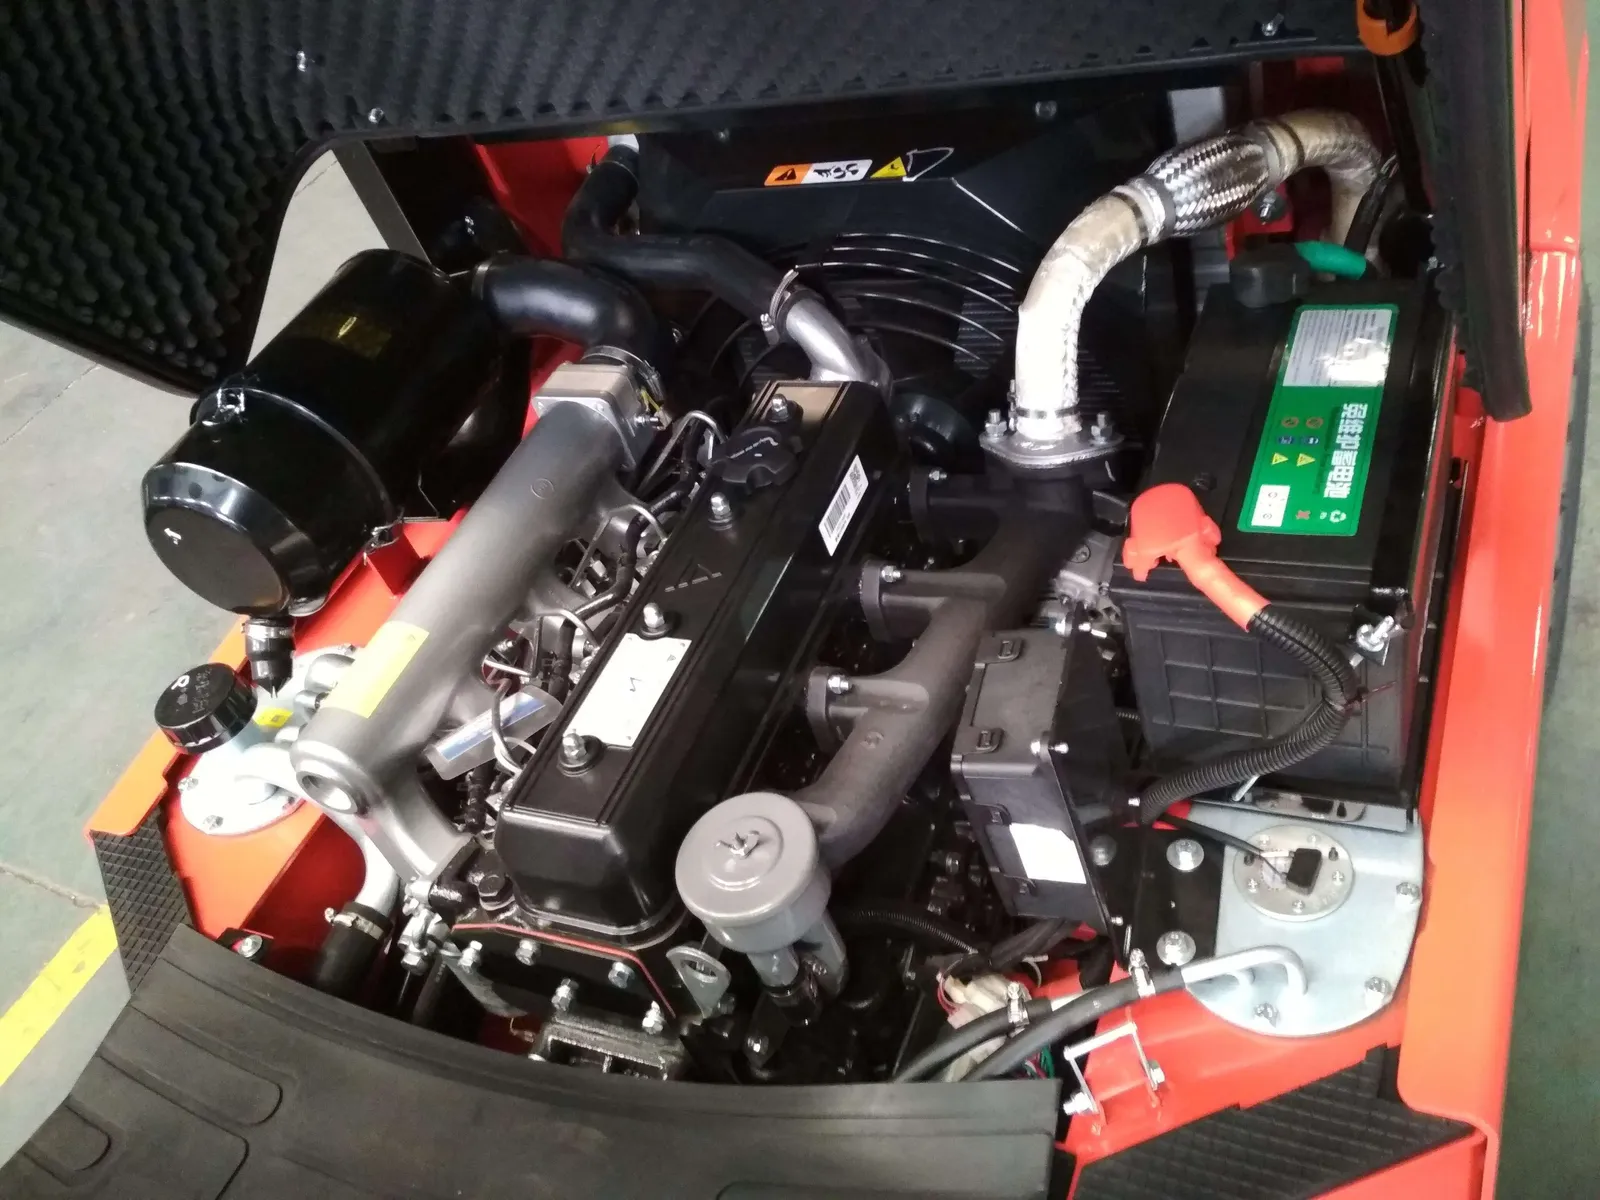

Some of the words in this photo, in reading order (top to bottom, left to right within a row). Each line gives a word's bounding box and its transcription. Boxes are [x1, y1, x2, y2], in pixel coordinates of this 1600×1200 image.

[1323, 403, 1368, 499] 免维护蓄电池
